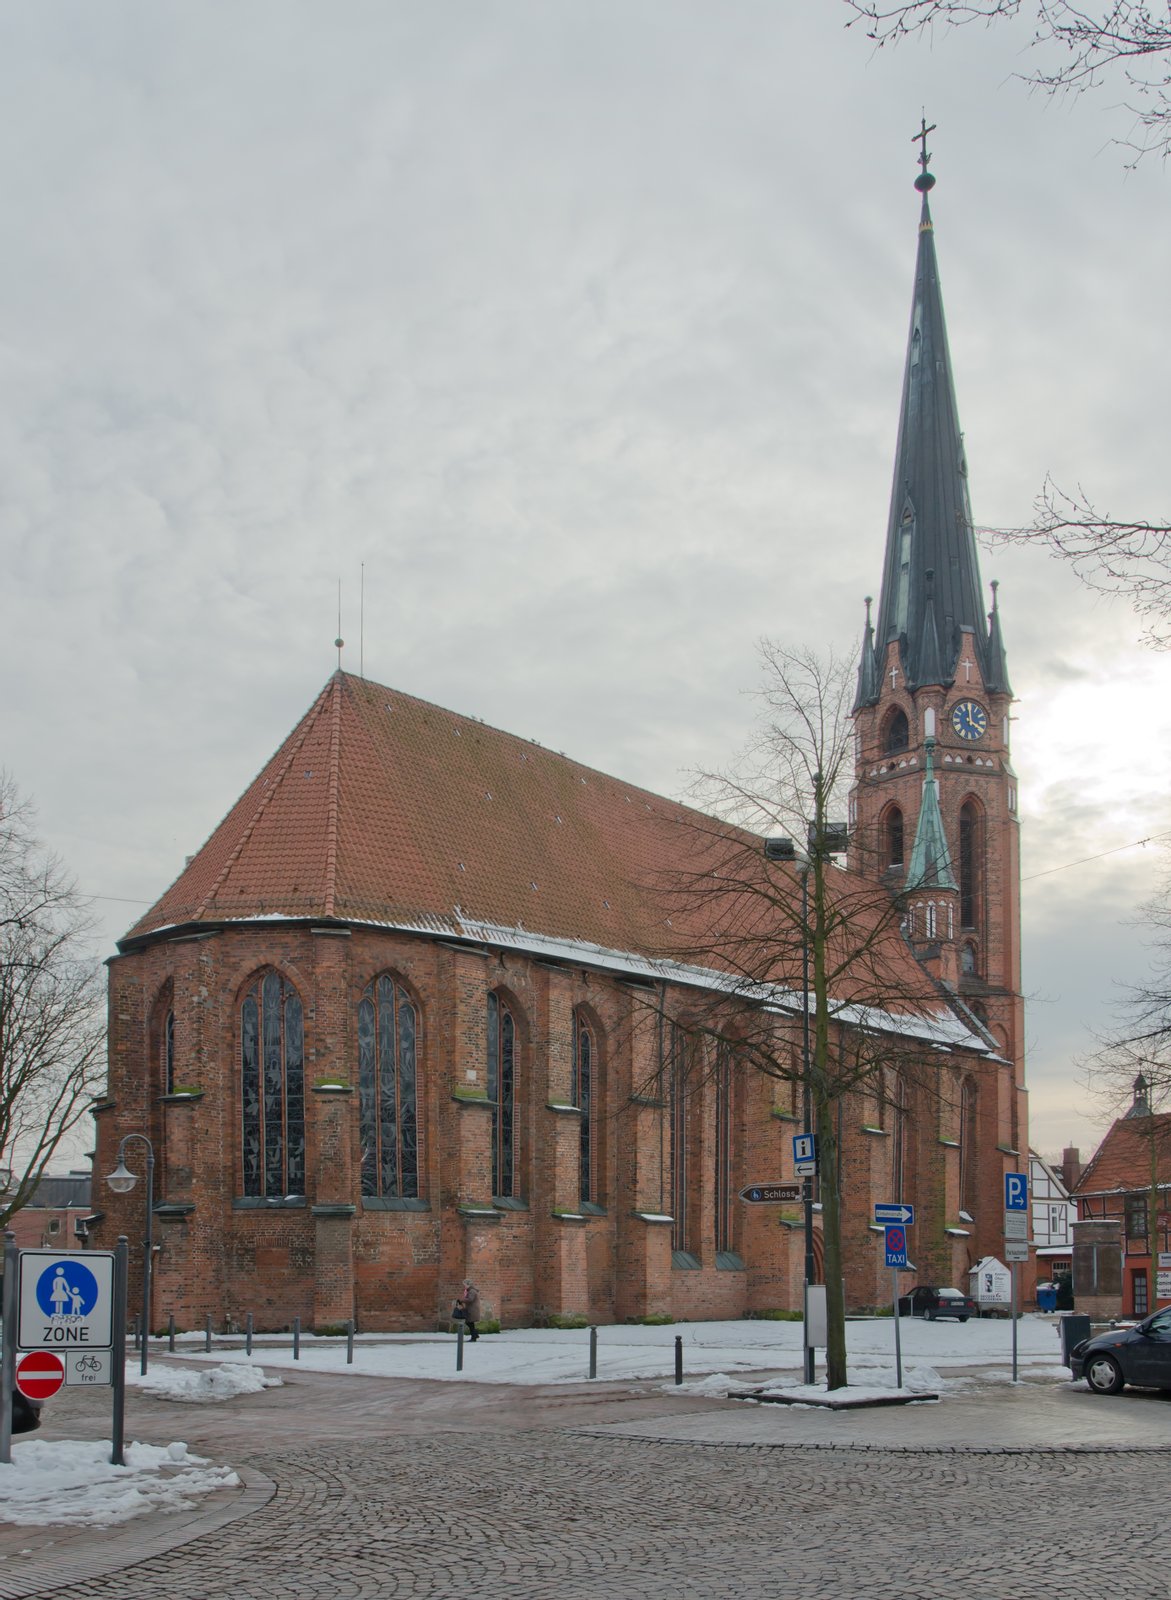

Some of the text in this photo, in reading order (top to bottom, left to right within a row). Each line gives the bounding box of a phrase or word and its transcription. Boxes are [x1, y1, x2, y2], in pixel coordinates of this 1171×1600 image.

[763, 1189, 796, 1199] Schloss
[1008, 1178, 1021, 1205] P
[887, 1254, 905, 1264] TAXI
[43, 1327, 89, 1341] ZONE
[81, 1373, 96, 1382] frei
